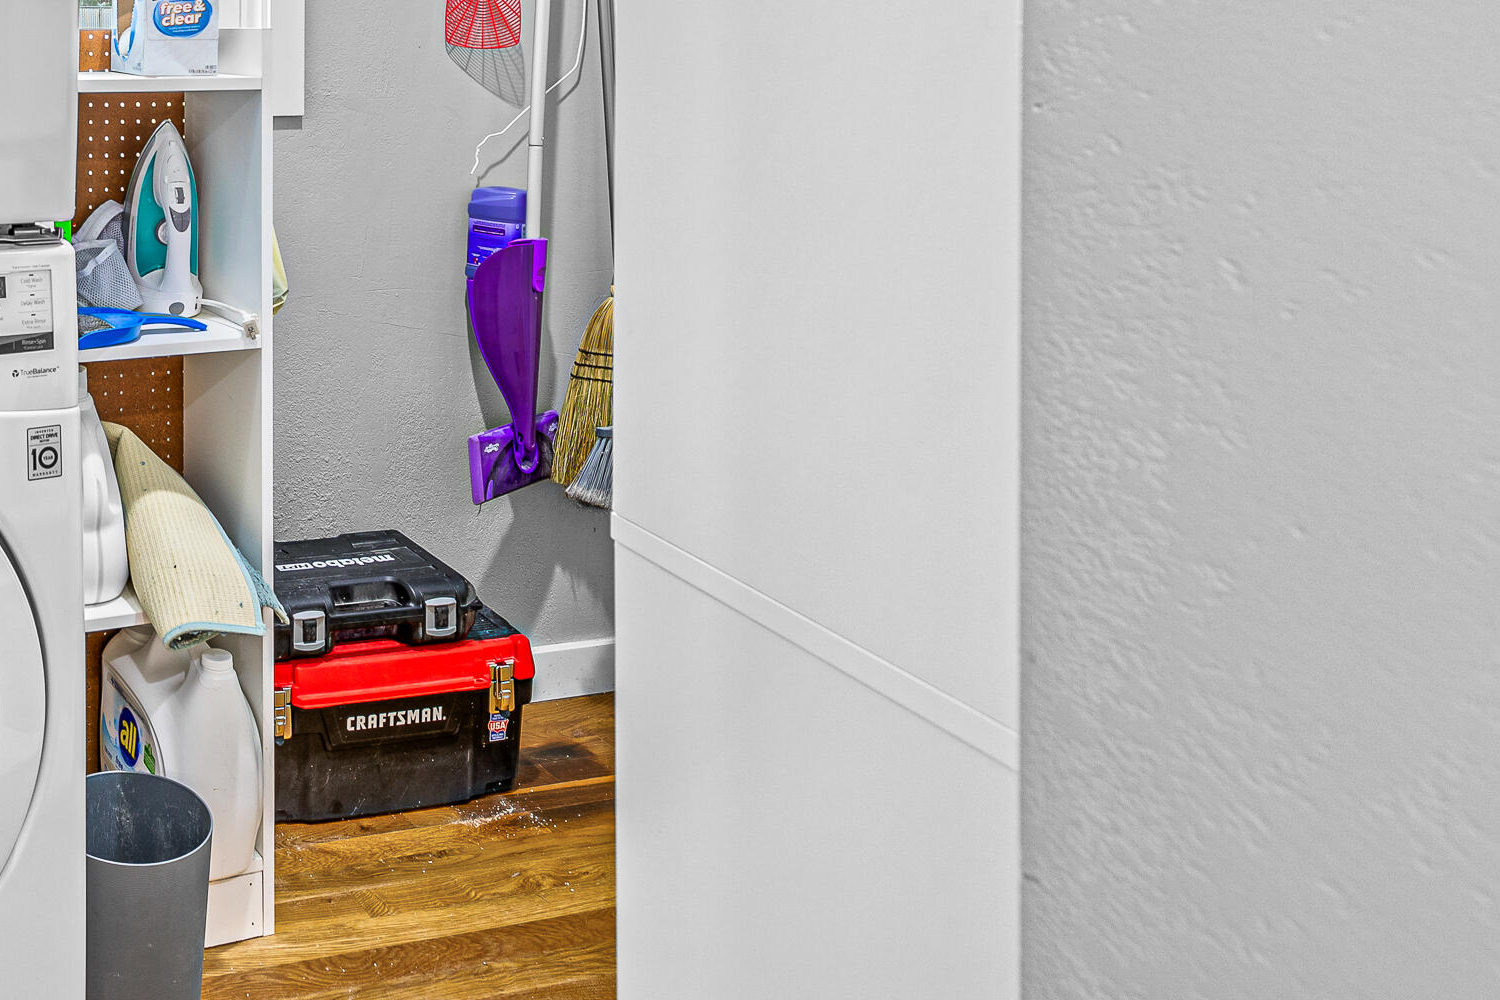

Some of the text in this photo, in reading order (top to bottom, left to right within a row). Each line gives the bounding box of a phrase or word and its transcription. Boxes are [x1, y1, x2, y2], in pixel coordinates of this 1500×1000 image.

[160, 1, 193, 15] free
[161, 12, 202, 27] clear
[31, 445, 59, 471] 10
[311, 553, 396, 569] metabo
[490, 721, 506, 730] USA
[120, 719, 137, 760] all
